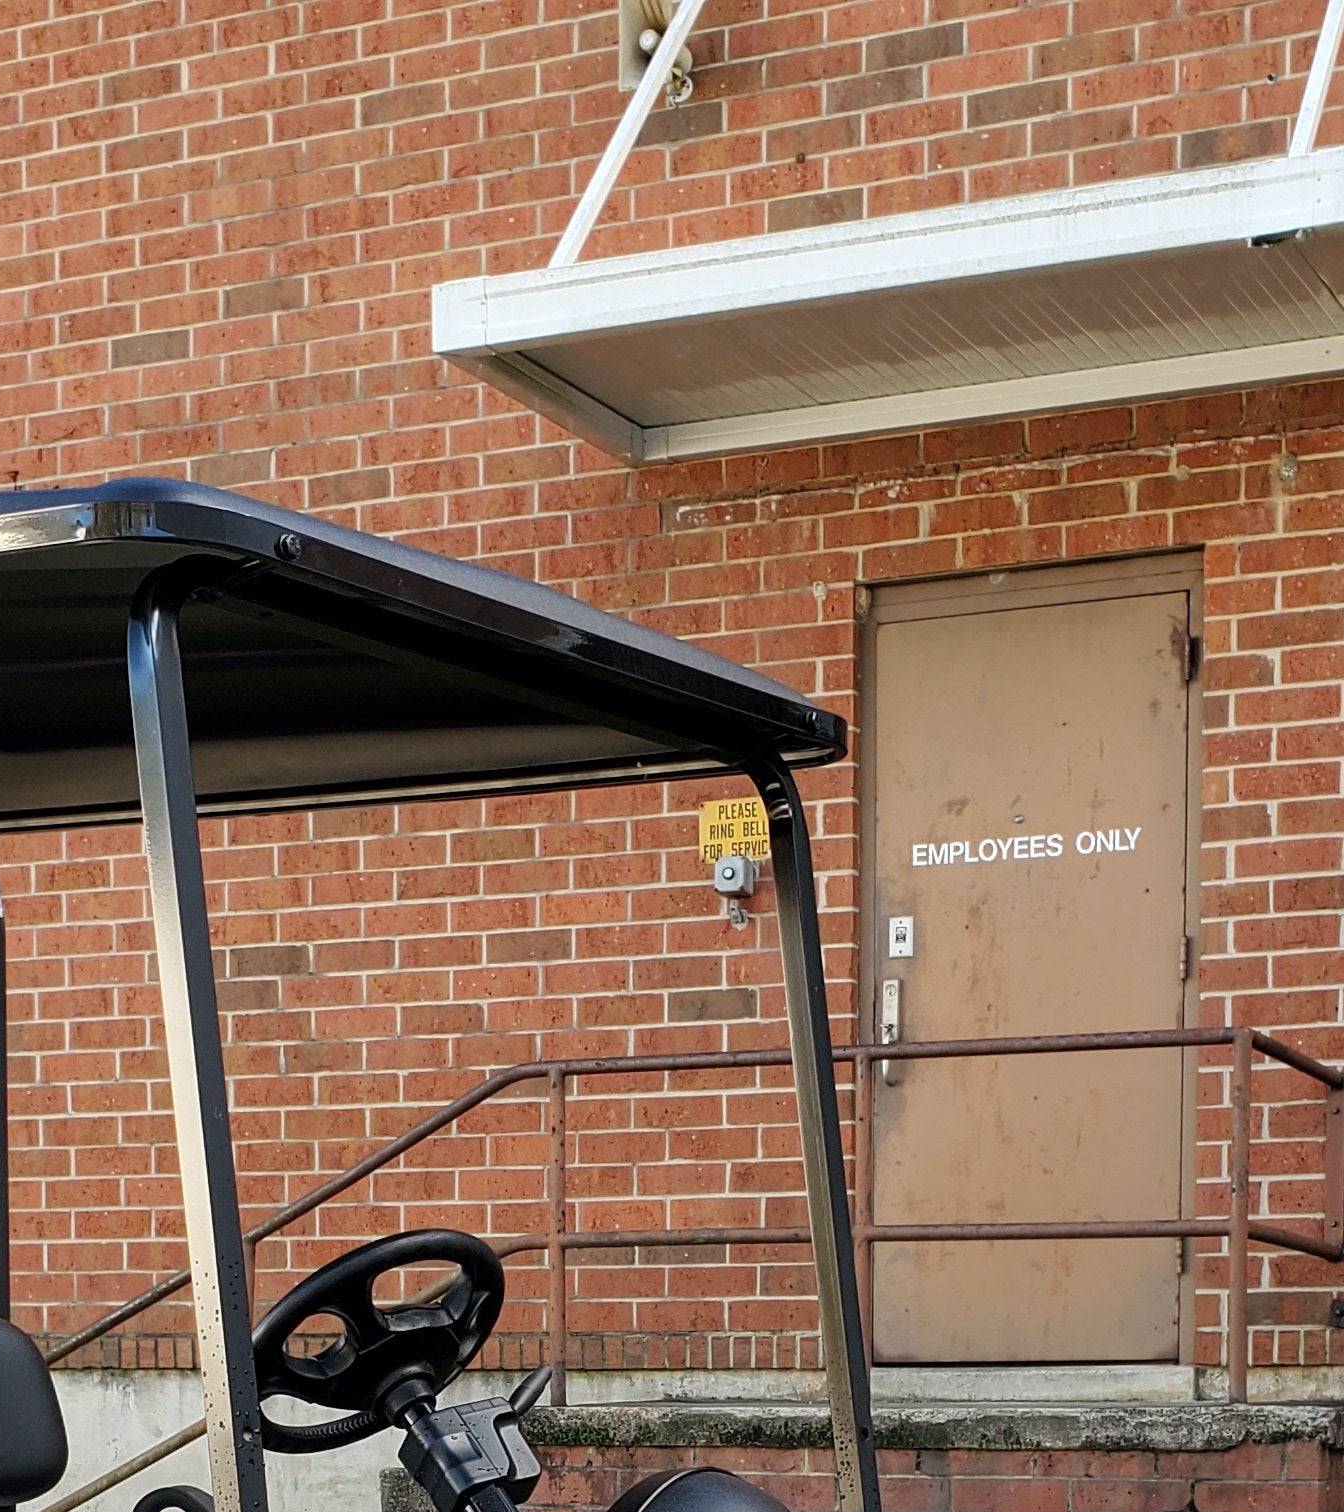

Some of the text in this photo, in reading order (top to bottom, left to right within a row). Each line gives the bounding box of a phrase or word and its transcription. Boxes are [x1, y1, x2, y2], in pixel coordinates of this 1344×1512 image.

[718, 802, 758, 820] PLEASE
[709, 820, 768, 840] RING BELL
[703, 839, 768, 860] FOR SERVIC
[912, 827, 1142, 867] EMPLOYEES ONLY
